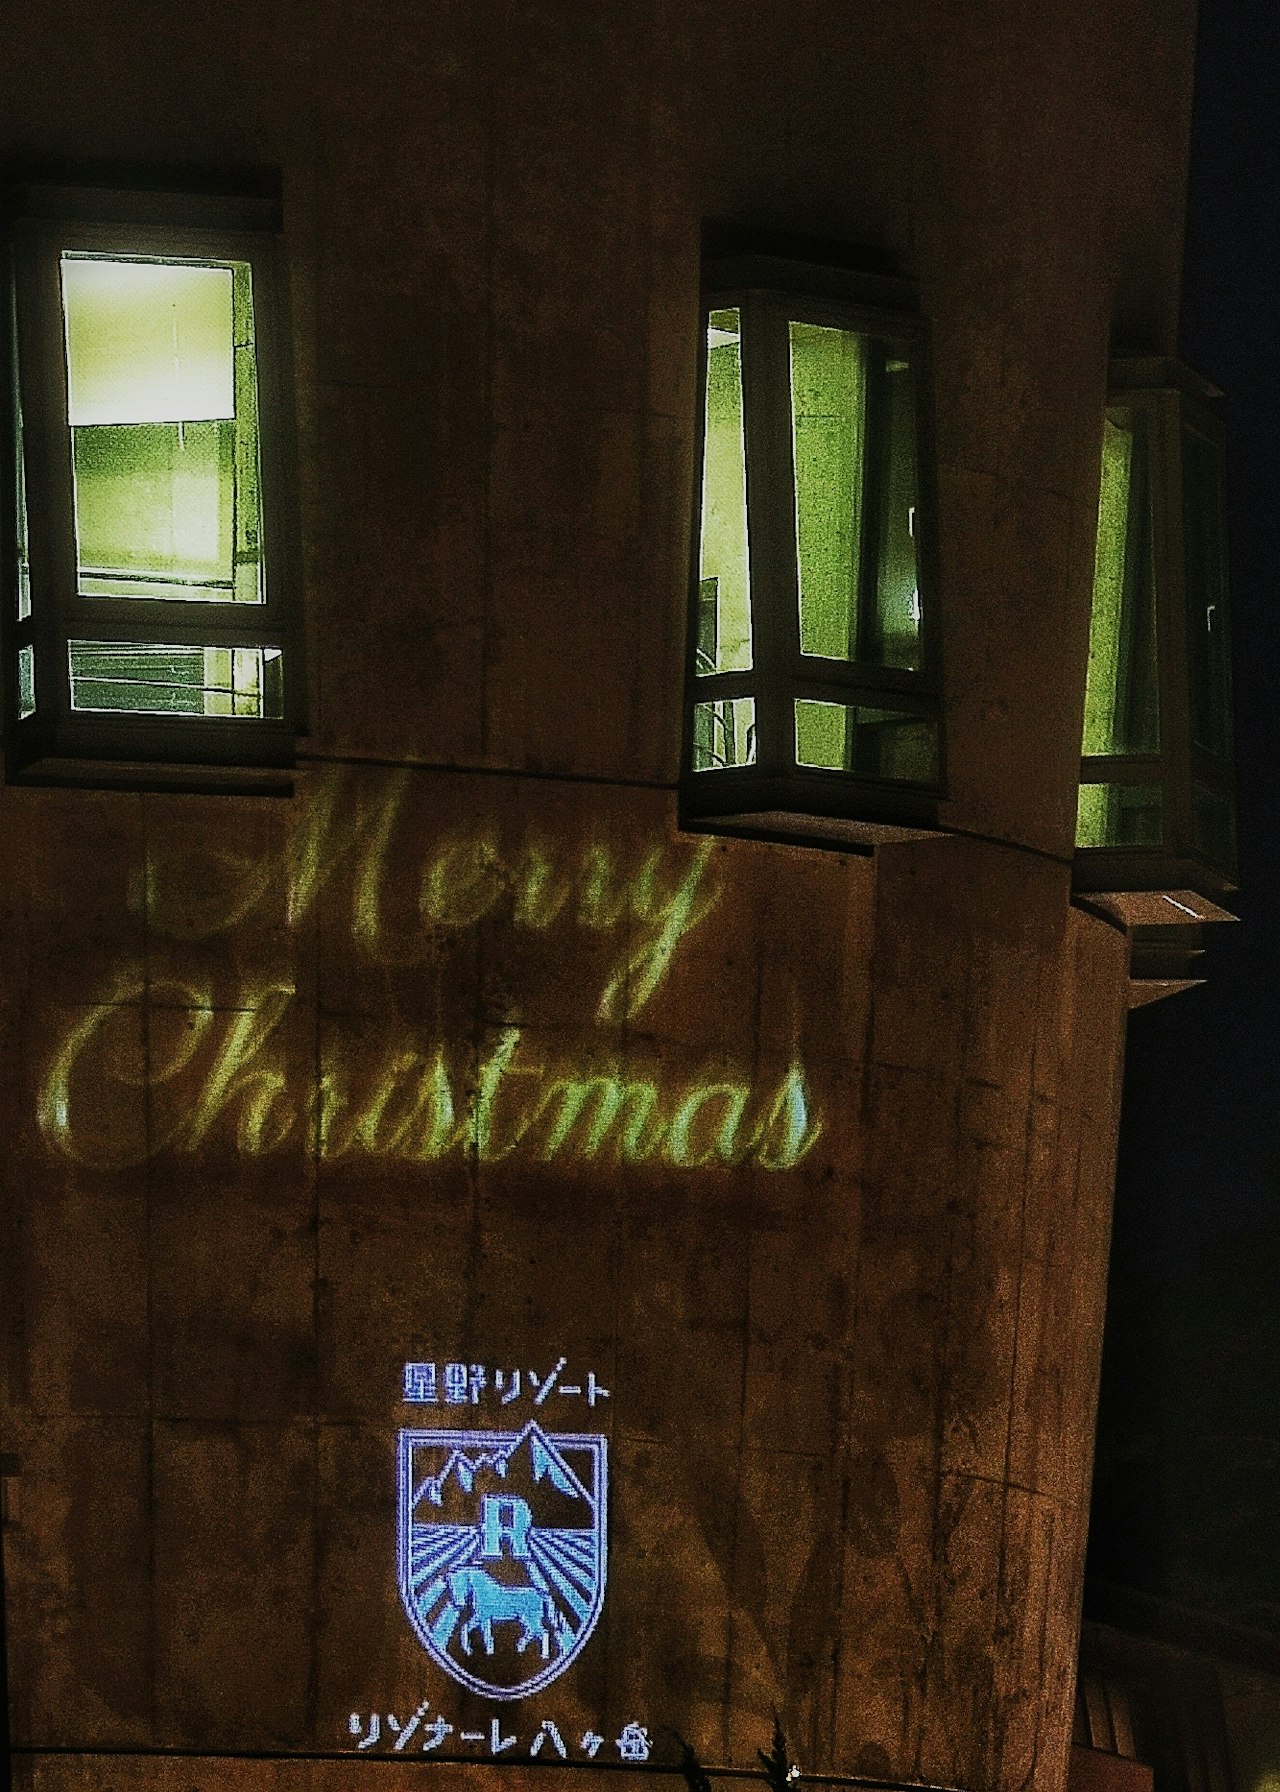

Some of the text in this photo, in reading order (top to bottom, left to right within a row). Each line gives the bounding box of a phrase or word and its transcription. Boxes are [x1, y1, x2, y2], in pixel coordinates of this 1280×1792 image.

[128, 752, 724, 1025] Merry
[36, 955, 824, 1172] Christmas
[402, 1357, 611, 1407] 星野リゾート
